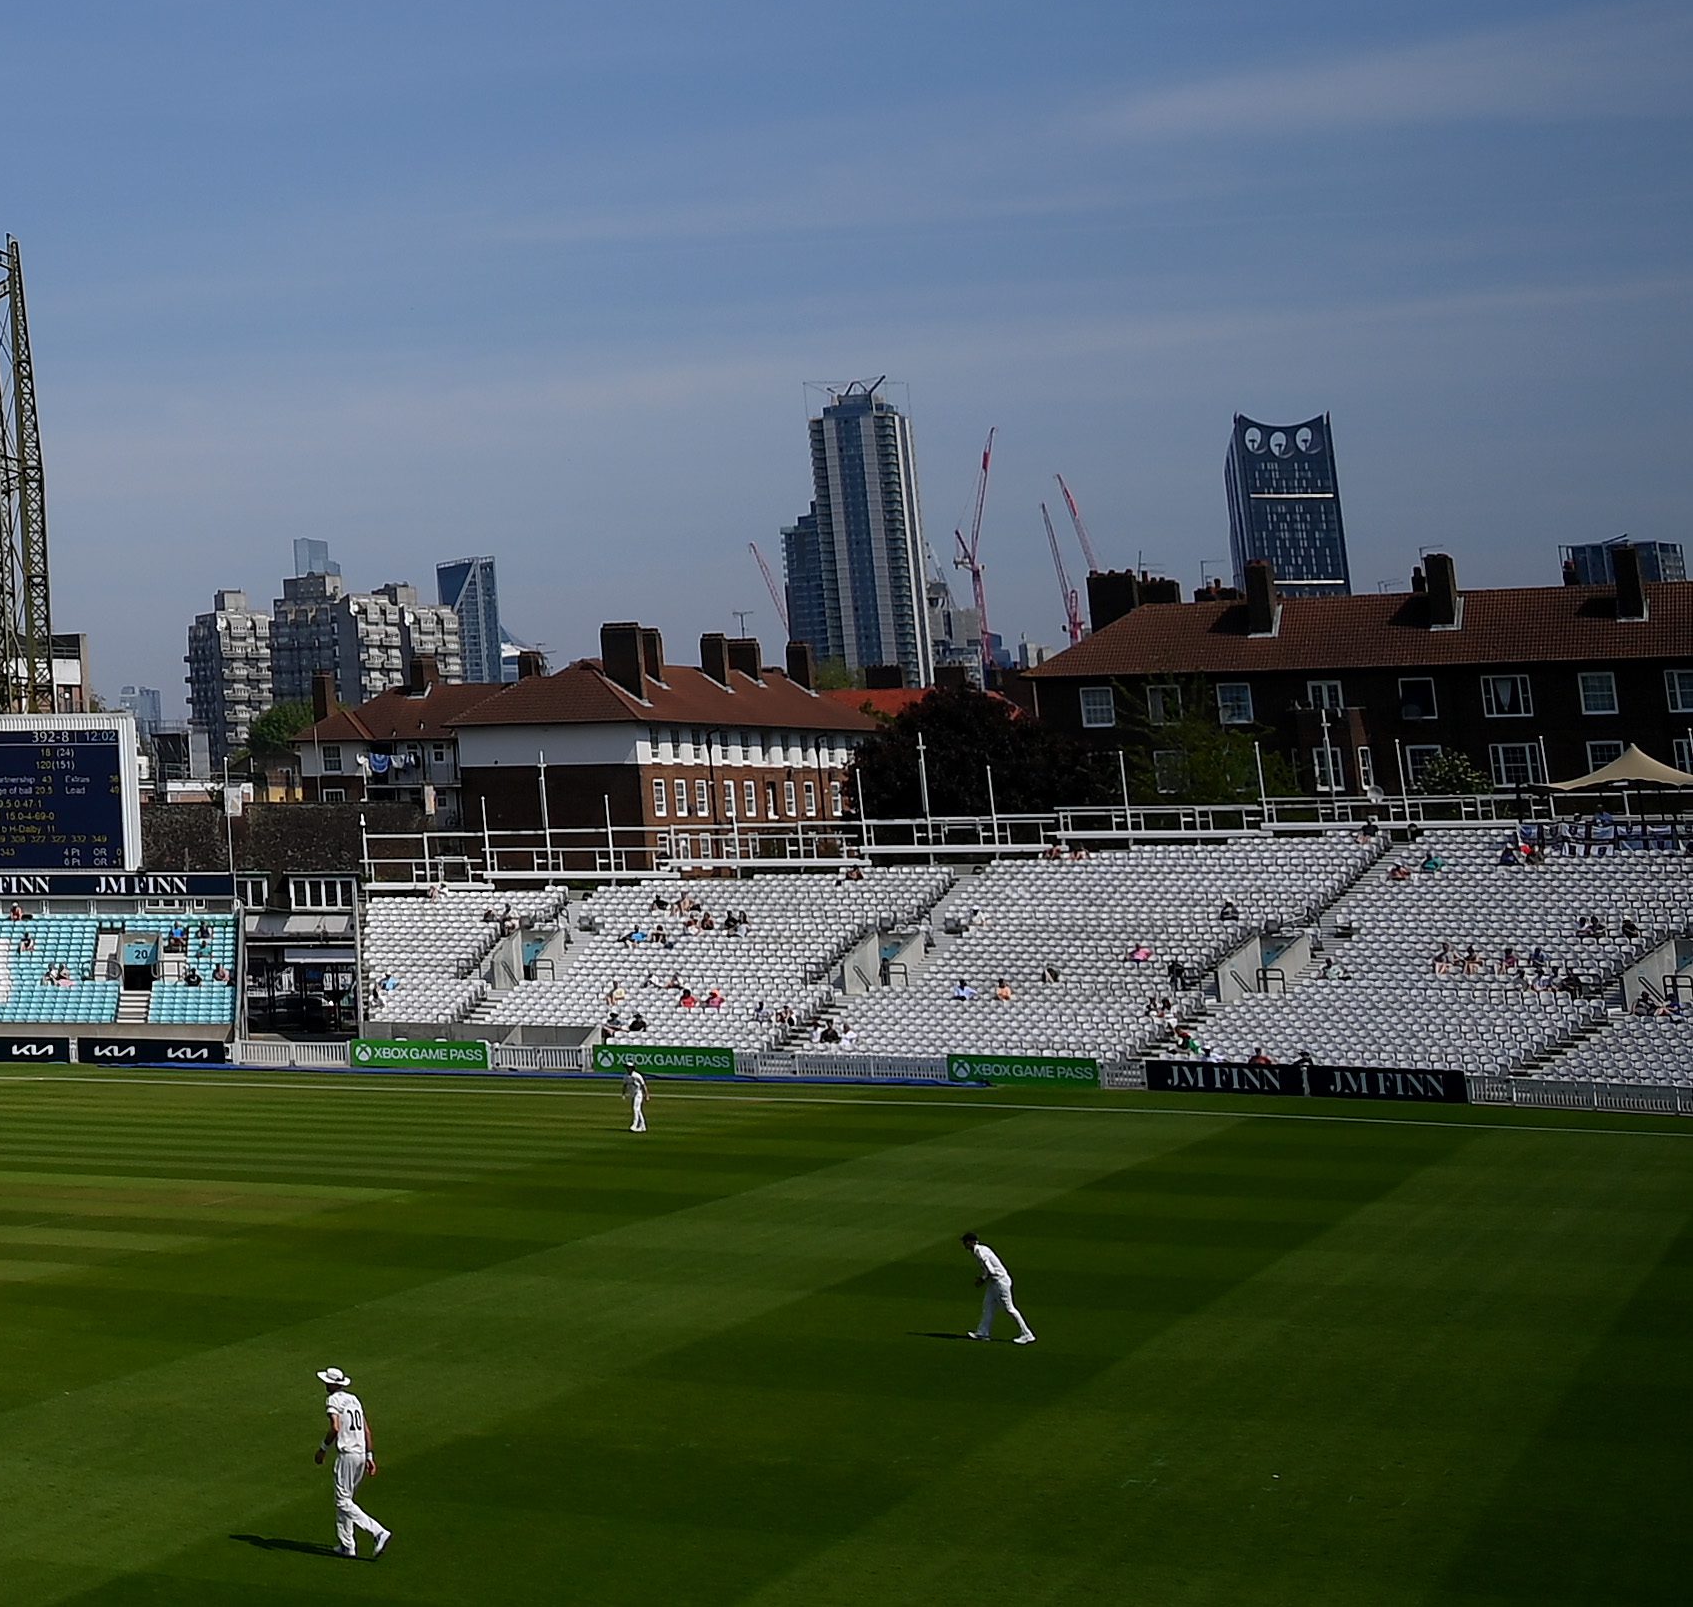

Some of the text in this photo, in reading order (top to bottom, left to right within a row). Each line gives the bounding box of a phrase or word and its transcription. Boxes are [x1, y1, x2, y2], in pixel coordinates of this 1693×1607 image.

[31, 731, 70, 743] 392-8
[84, 731, 116, 742] 12:02
[95, 876, 187, 893] JM FINN
[134, 949, 148, 959] 20
[373, 1046, 483, 1061] XBOX GAME PASS
[616, 1053, 730, 1068] XBOX GAME PASS
[972, 1062, 1094, 1081] XBOX GAME PASS
[1167, 1065, 1282, 1091] JM FINN
[1329, 1070, 1446, 1097] JM FINN
